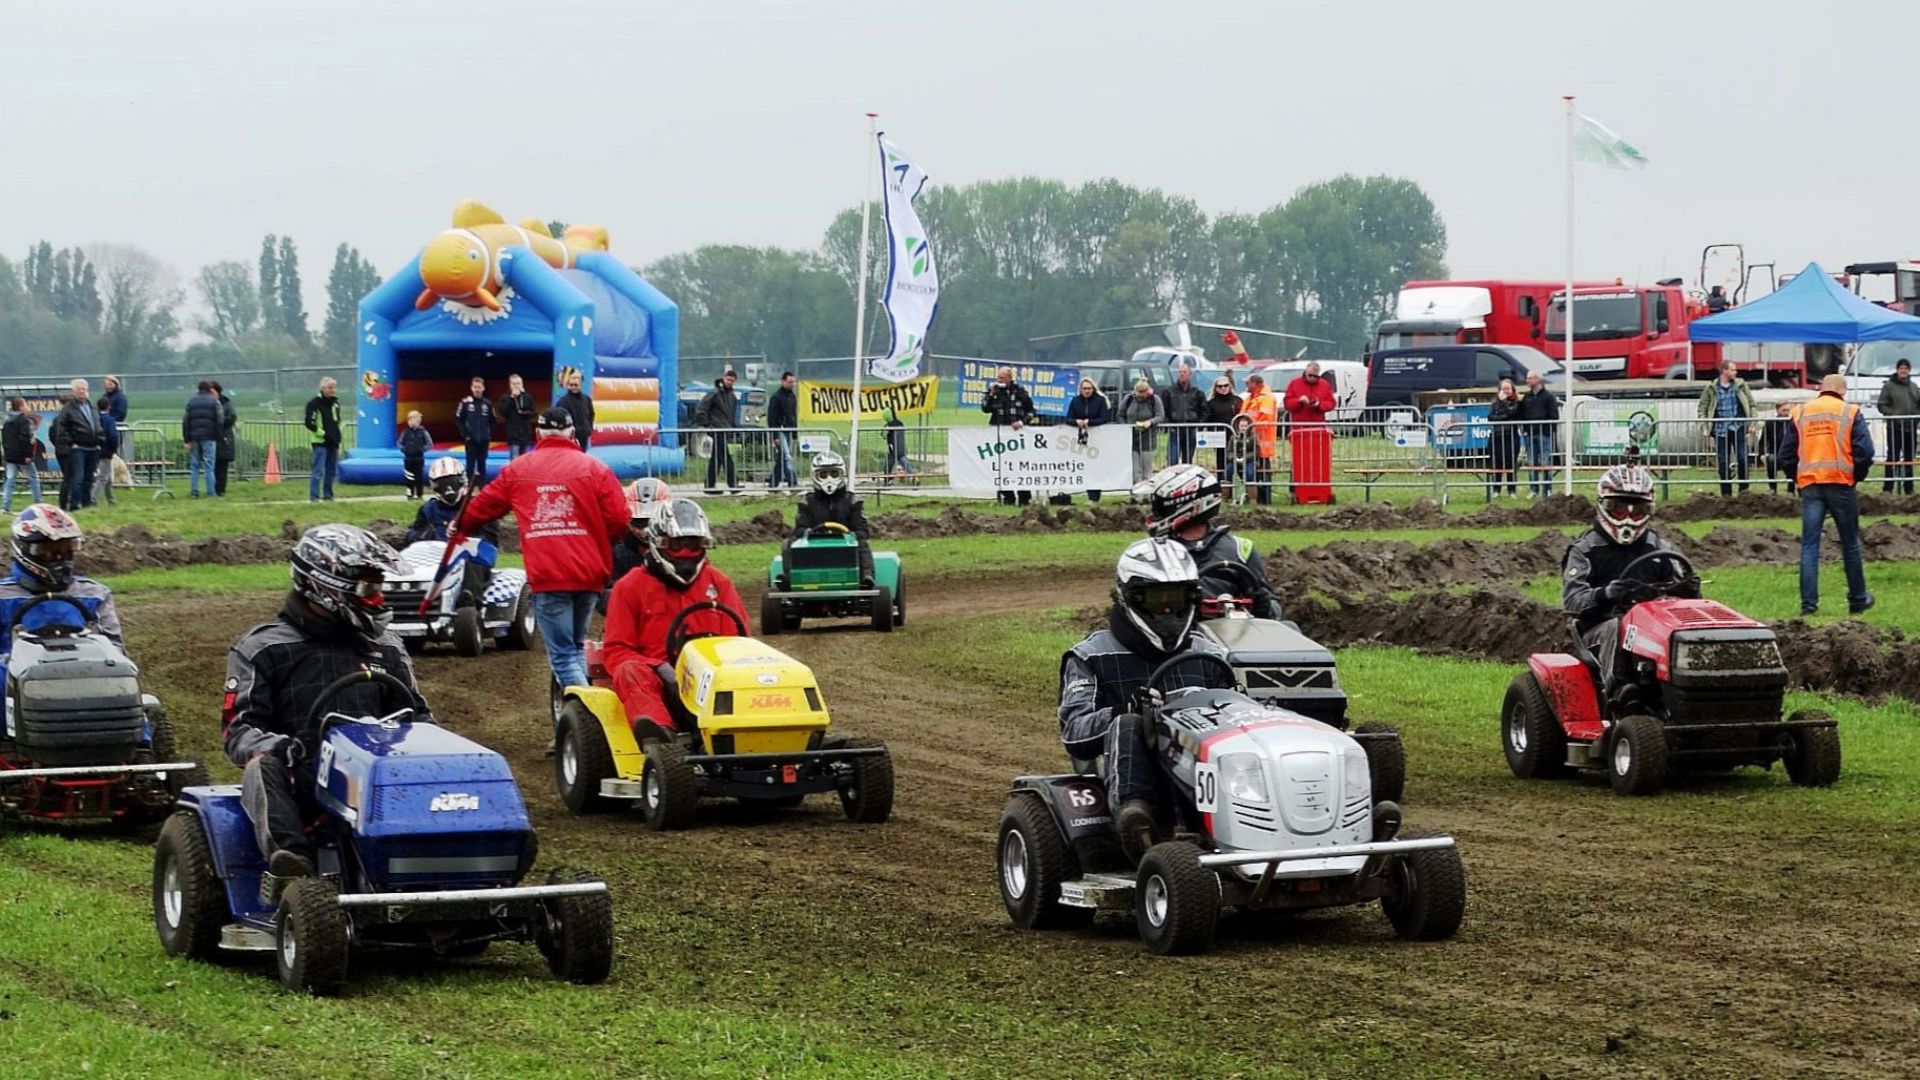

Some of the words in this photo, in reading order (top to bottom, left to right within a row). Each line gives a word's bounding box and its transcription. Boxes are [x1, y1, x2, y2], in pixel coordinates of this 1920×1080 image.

[811, 383, 930, 413] RONDLUCHTEN
[977, 434, 1026, 460] Hooi
[1034, 433, 1048, 449] &
[1019, 459, 1085, 473] Mannetje
[536, 485, 567, 493] OFFICIAL
[531, 521, 565, 529] STICHTING
[1198, 770, 1215, 805] 50
[430, 793, 479, 811] KTM
